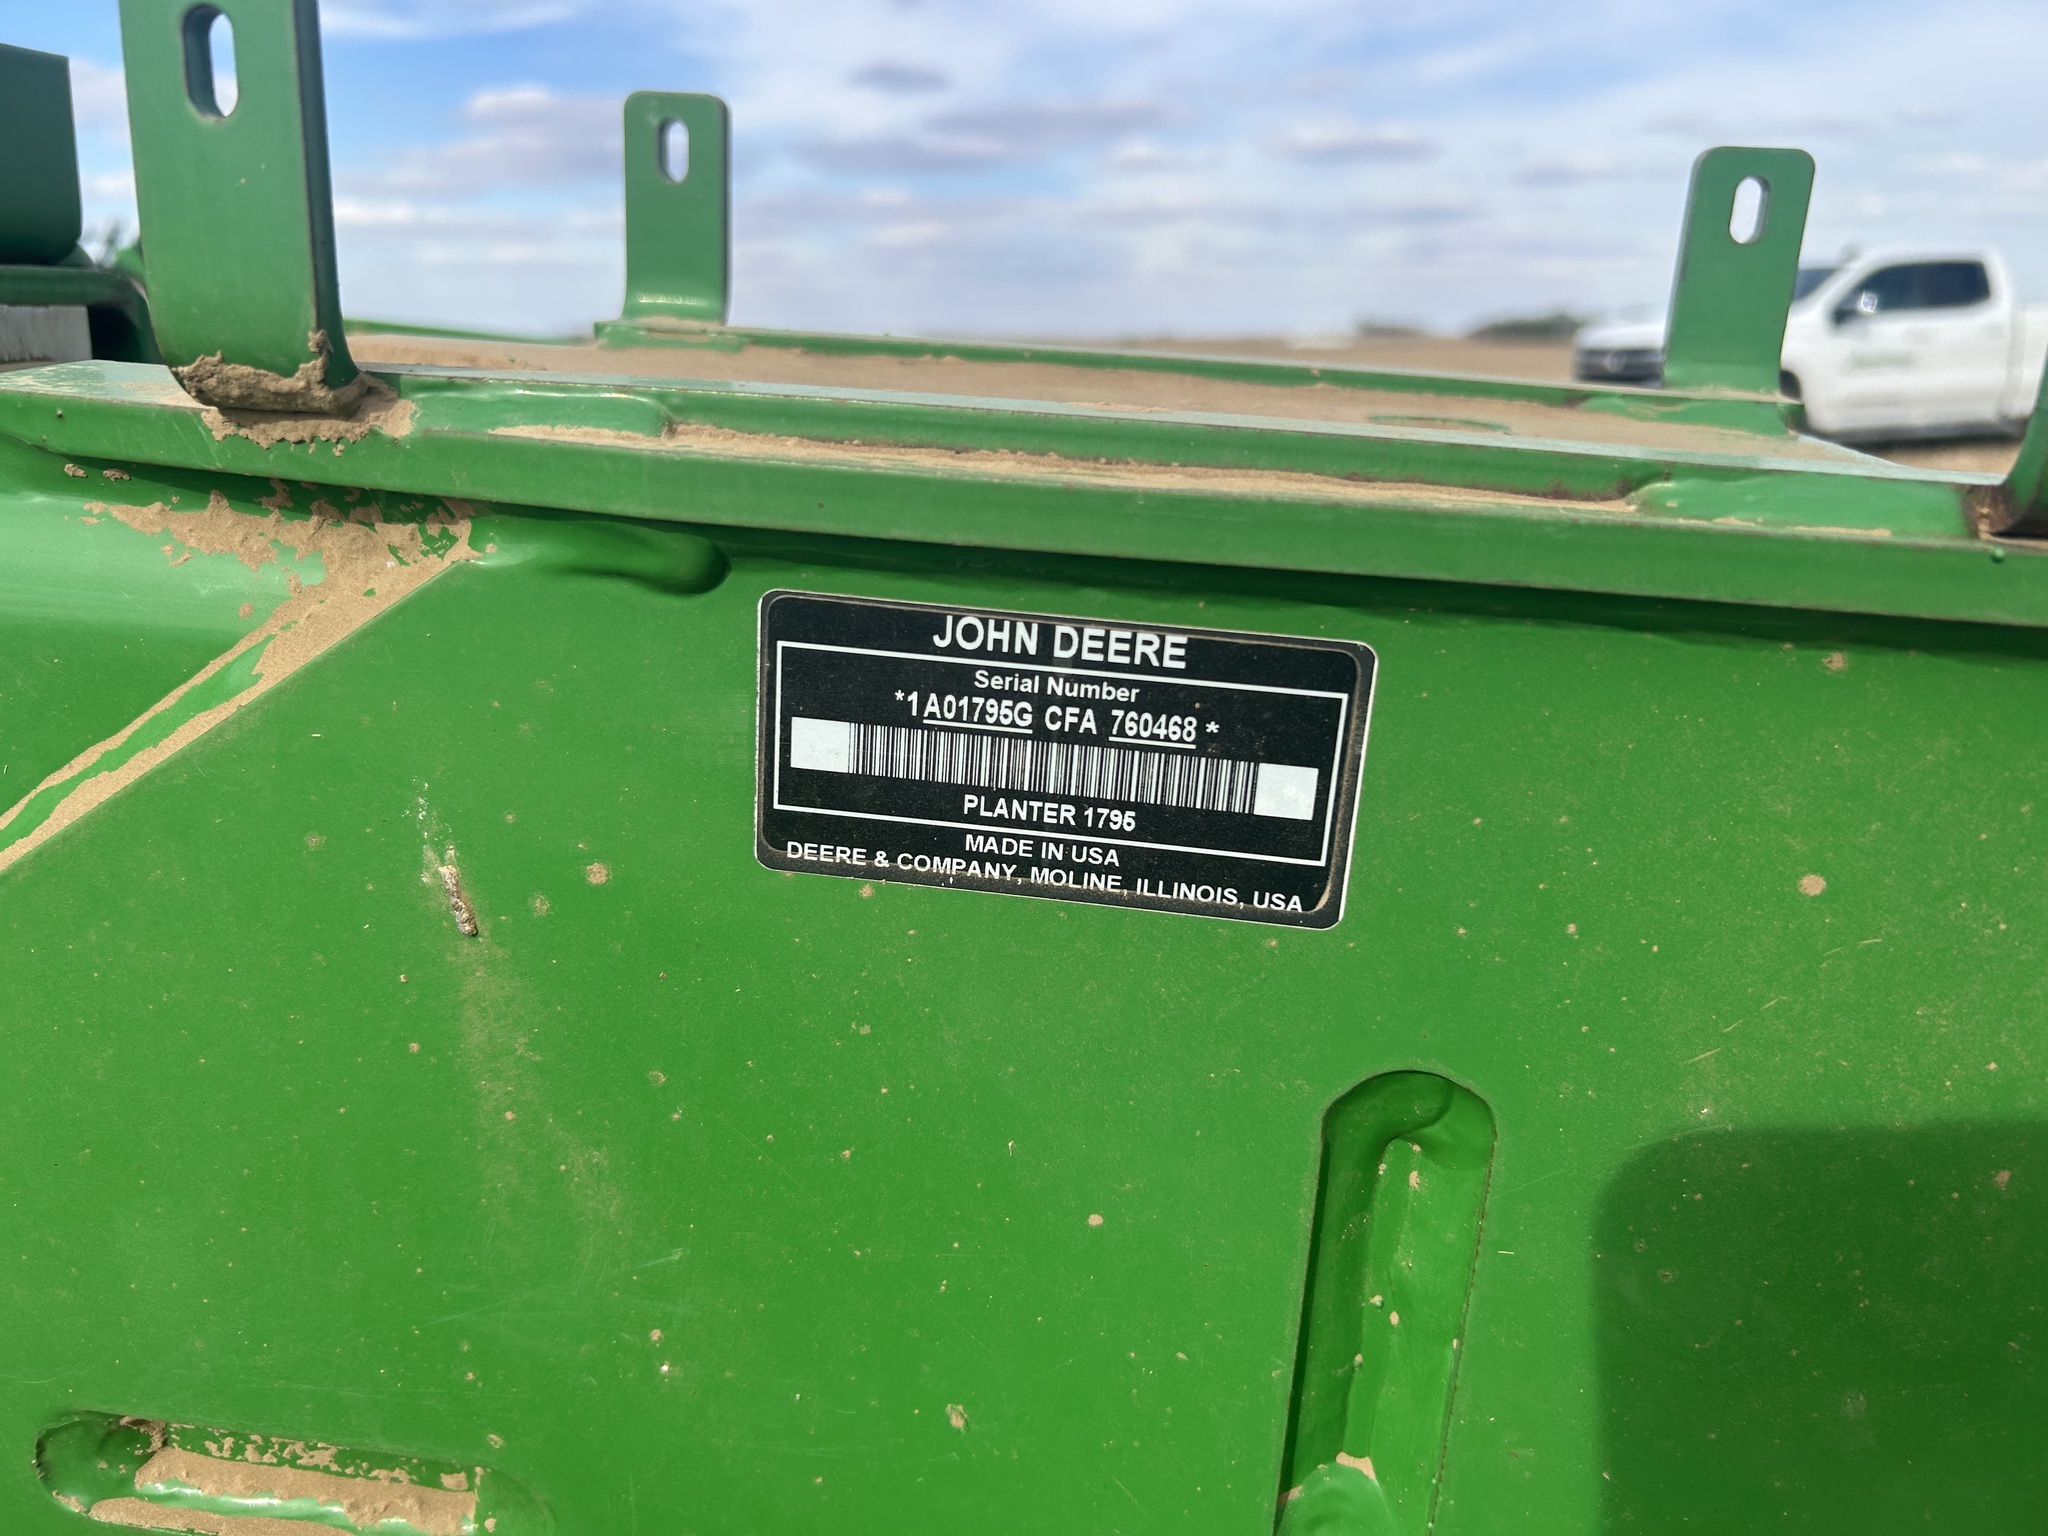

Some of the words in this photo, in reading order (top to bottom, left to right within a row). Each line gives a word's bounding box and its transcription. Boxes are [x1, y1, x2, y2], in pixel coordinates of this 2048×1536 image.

[933, 615, 1038, 656] JOHN
[1054, 625, 1188, 669] DEERE
[974, 670, 1038, 694] Serial
[1047, 677, 1140, 702] Number
[1044, 706, 1098, 734] CFA
[964, 794, 1076, 827] PLANTER
[965, 834, 1033, 858] MADE
[1041, 842, 1063, 861] IN
[1072, 845, 1120, 867] USA
[787, 841, 867, 866] DEERE
[874, 850, 890, 868] &
[897, 853, 1023, 885] COMPANY,
[1031, 866, 1128, 896] MOLINE,
[1136, 878, 1244, 909] ILLINOIS,
[1252, 891, 1303, 913] USA
